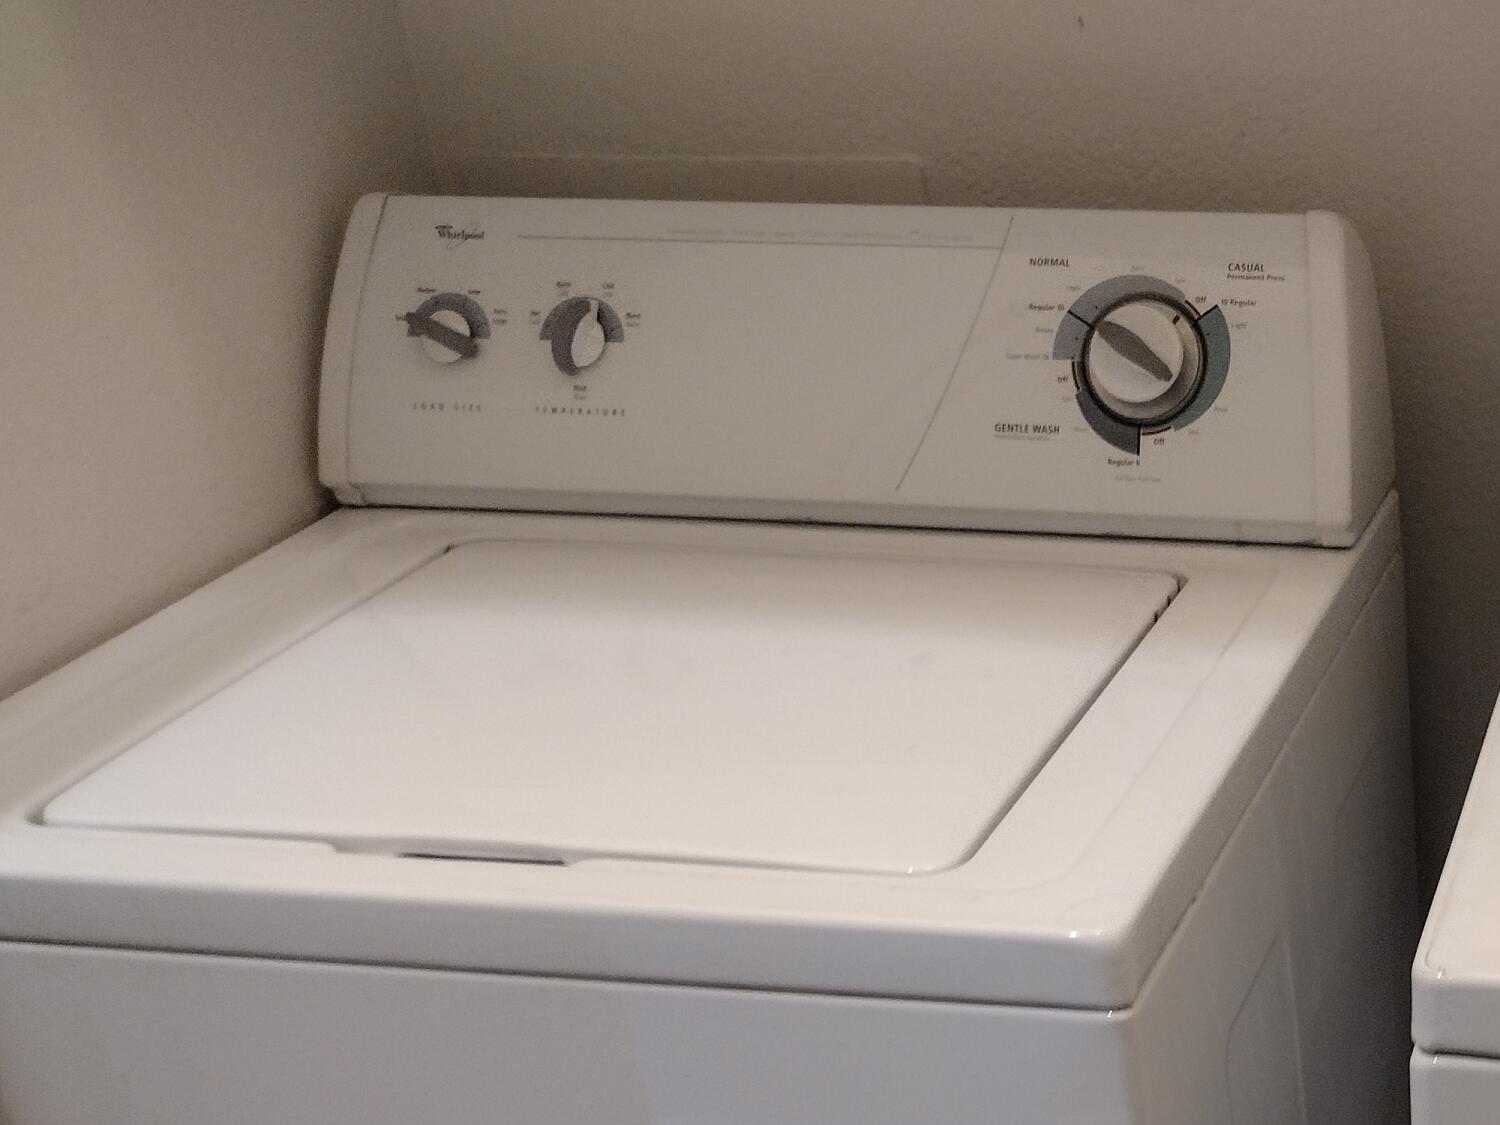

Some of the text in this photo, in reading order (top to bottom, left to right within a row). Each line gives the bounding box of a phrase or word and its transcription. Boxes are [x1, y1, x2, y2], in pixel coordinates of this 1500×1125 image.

[1029, 258, 1070, 267] NORMAL
[1227, 263, 1264, 272] CASUAL
[994, 423, 1060, 435] GENTLE WASH
